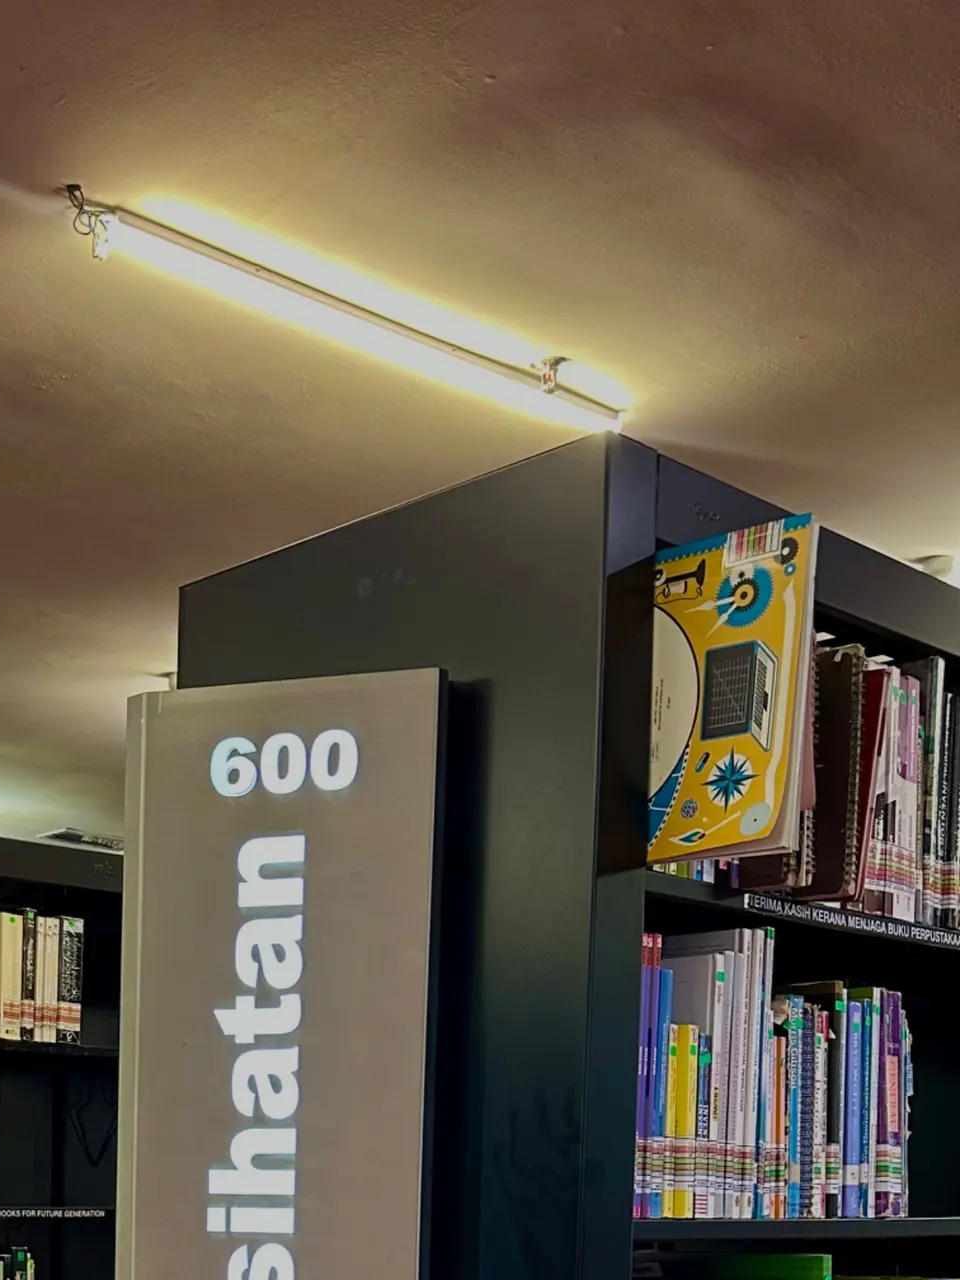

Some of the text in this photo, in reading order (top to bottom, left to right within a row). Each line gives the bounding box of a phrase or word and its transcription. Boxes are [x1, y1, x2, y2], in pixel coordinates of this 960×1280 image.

[210, 729, 359, 797] 600
[747, 893, 783, 914] TERIMA
[783, 902, 812, 919] KASIH
[812, 907, 847, 926] KERANA
[847, 915, 888, 934] MENJAGA
[887, 922, 910, 938] BUKU
[789, 1047, 798, 1089] Gibson
[22, 1209, 36, 1218] FOR
[37, 1209, 64, 1218] FUTURE
[65, 1209, 106, 1218] GENERATION
